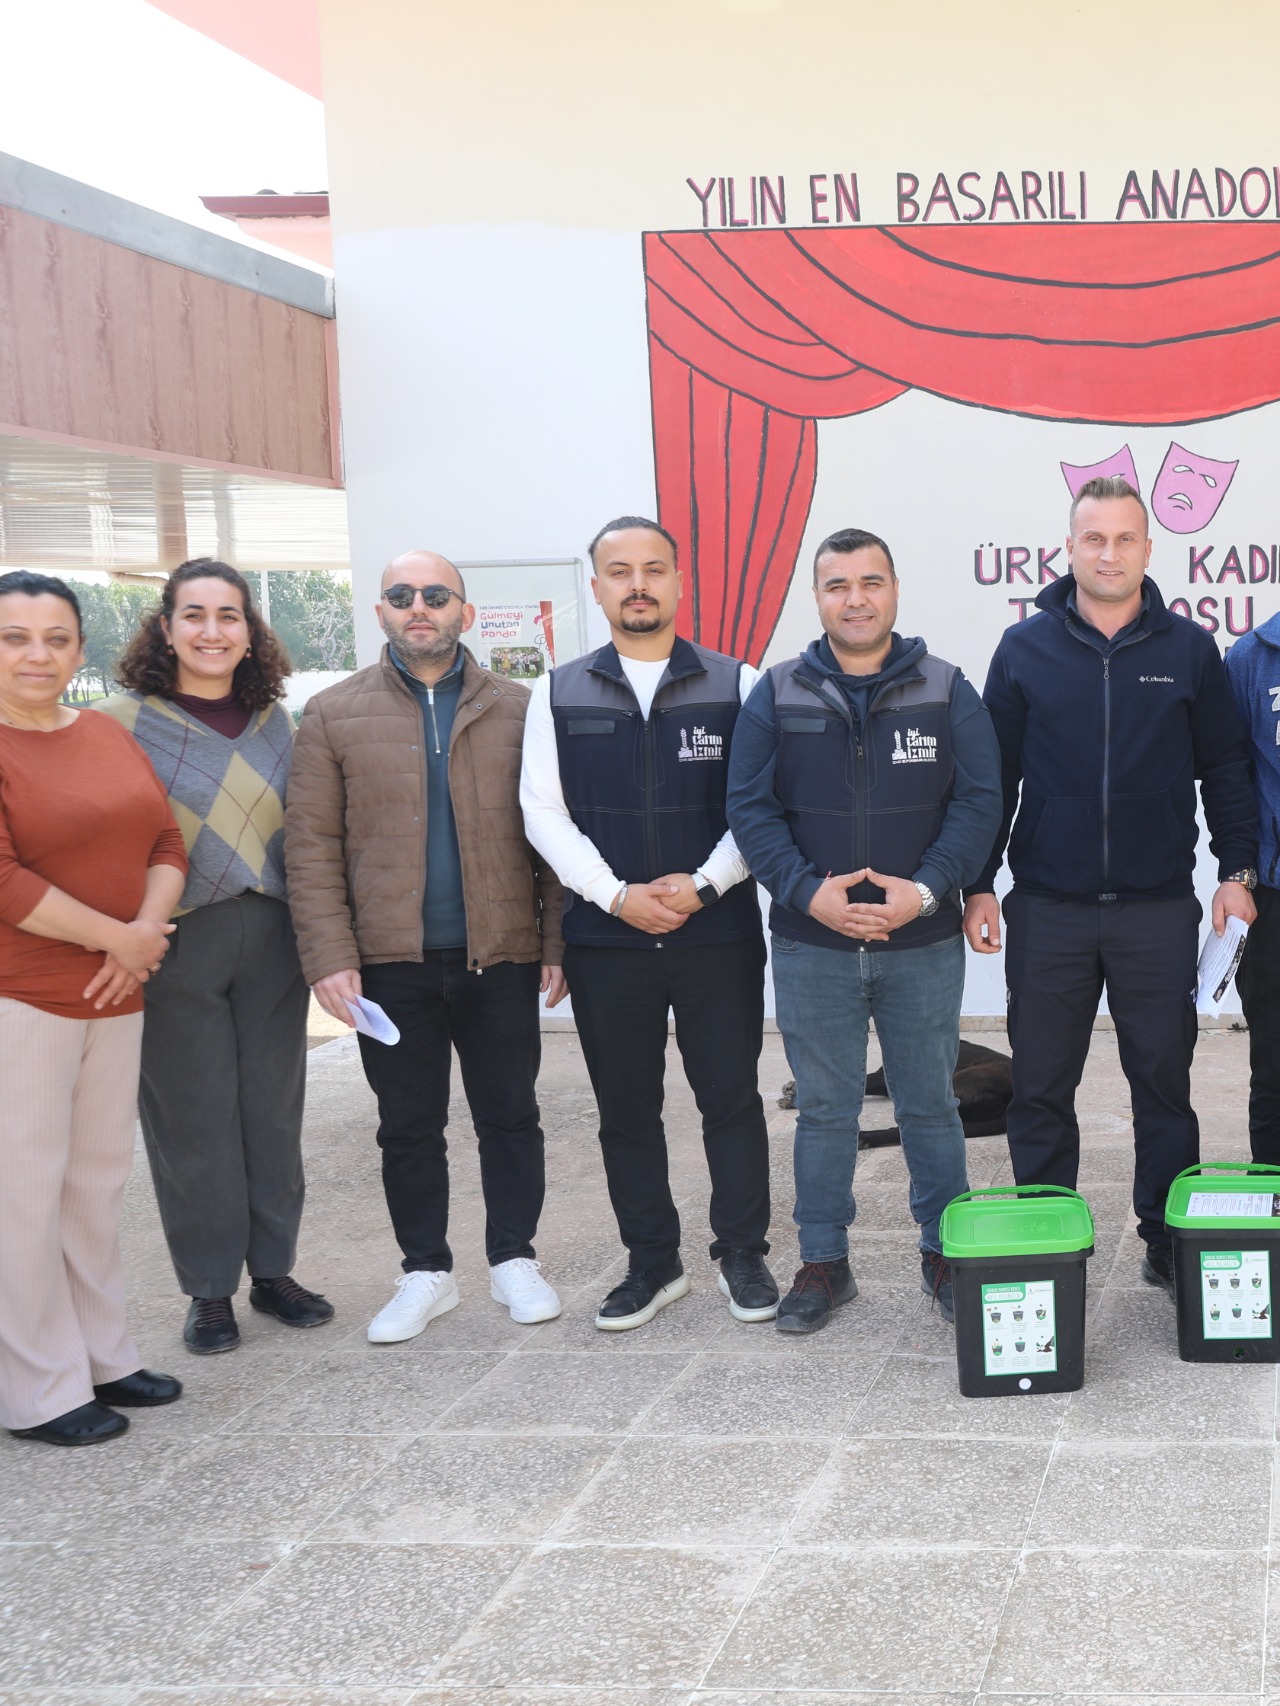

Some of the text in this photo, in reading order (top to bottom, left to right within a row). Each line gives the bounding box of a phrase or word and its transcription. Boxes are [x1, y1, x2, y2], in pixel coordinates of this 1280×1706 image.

[686, 175, 786, 227] YILIN
[809, 173, 861, 223] EN
[480, 610, 524, 620] Gülmeyi
[481, 620, 520, 629] Unutan
